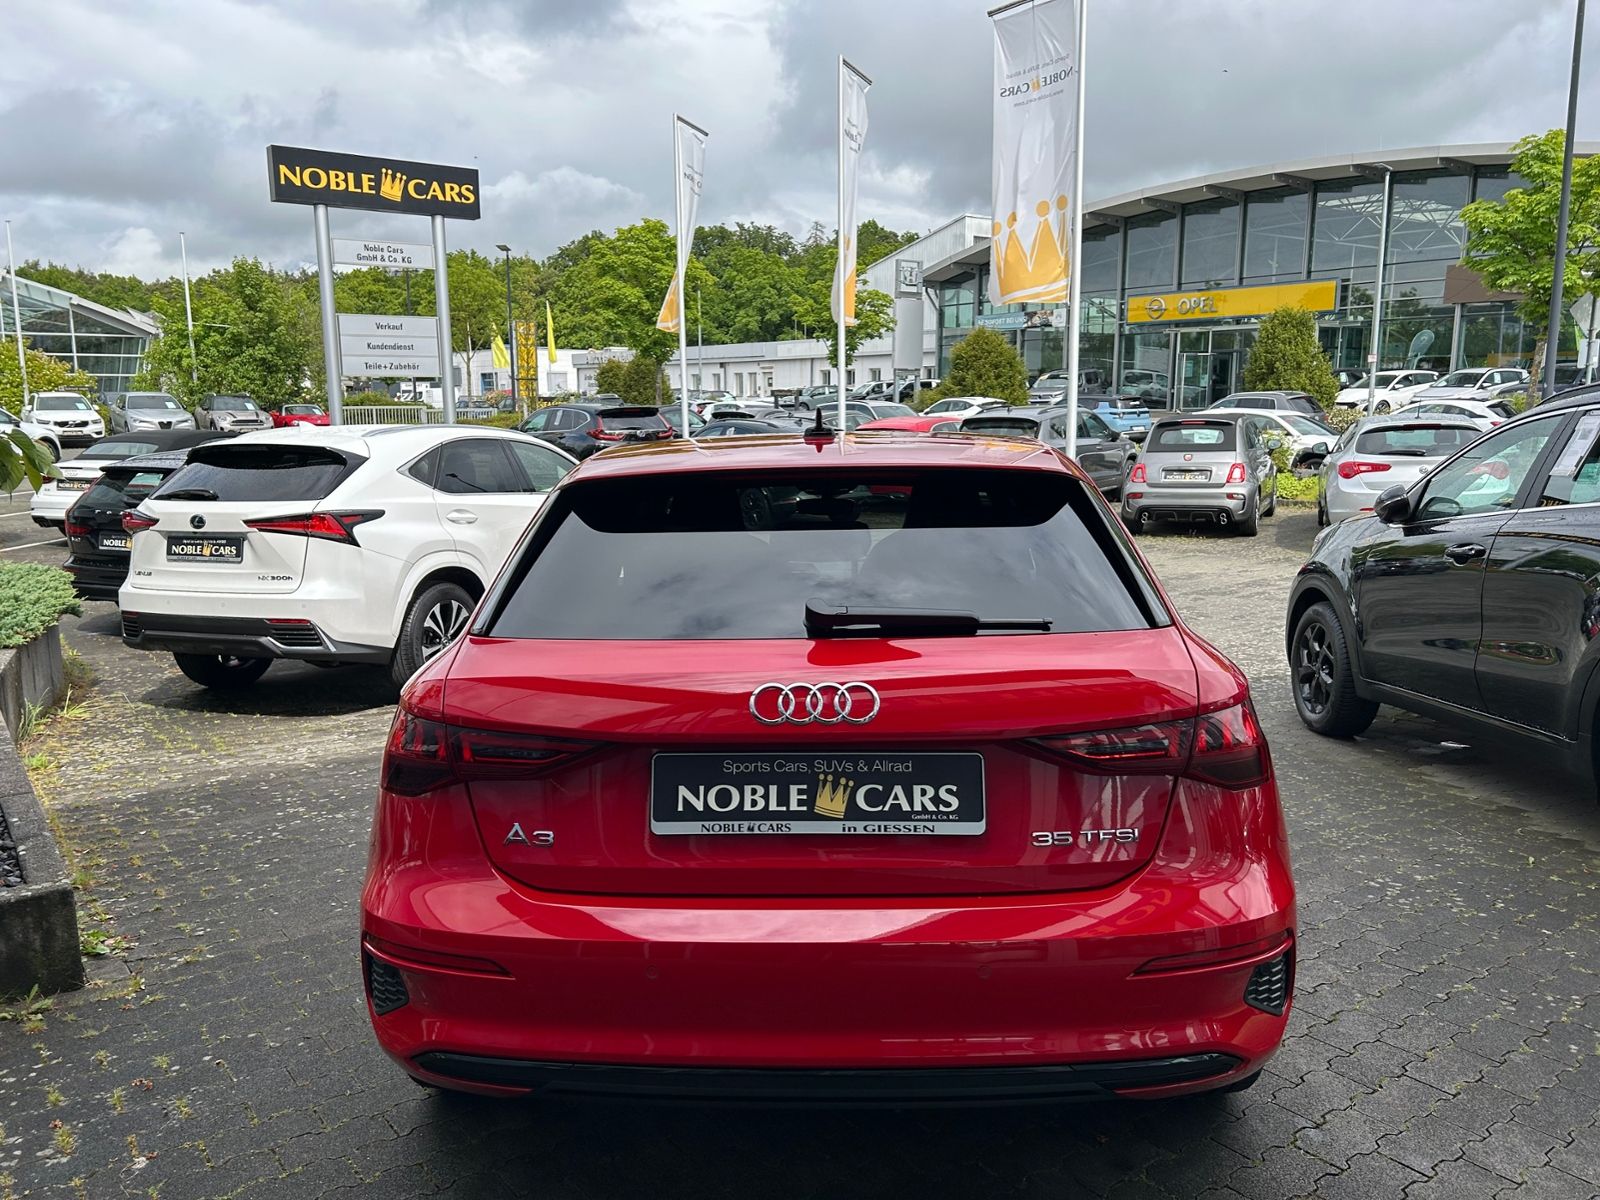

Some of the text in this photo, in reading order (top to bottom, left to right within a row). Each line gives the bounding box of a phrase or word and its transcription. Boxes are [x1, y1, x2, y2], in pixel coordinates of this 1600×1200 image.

[279, 164, 475, 204] NOBLE CARS
[363, 244, 404, 254] Noble Cars
[356, 253, 412, 264] GmbH & Co. KG
[1177, 296, 1217, 315] OPEL
[375, 322, 403, 331] Verkauf
[367, 342, 414, 351] Kundendienst
[103, 539, 126, 547] NOBLE
[171, 545, 237, 555] NOBLE CARS
[723, 760, 912, 775] Sports Cars, SUVs & Allrad
[677, 784, 959, 812] NOBLE CARS
[701, 823, 935, 833] NOBLE CARS in GIESSEN
[503, 822, 554, 847] A3
[1032, 828, 1139, 846] 35 TFSI
